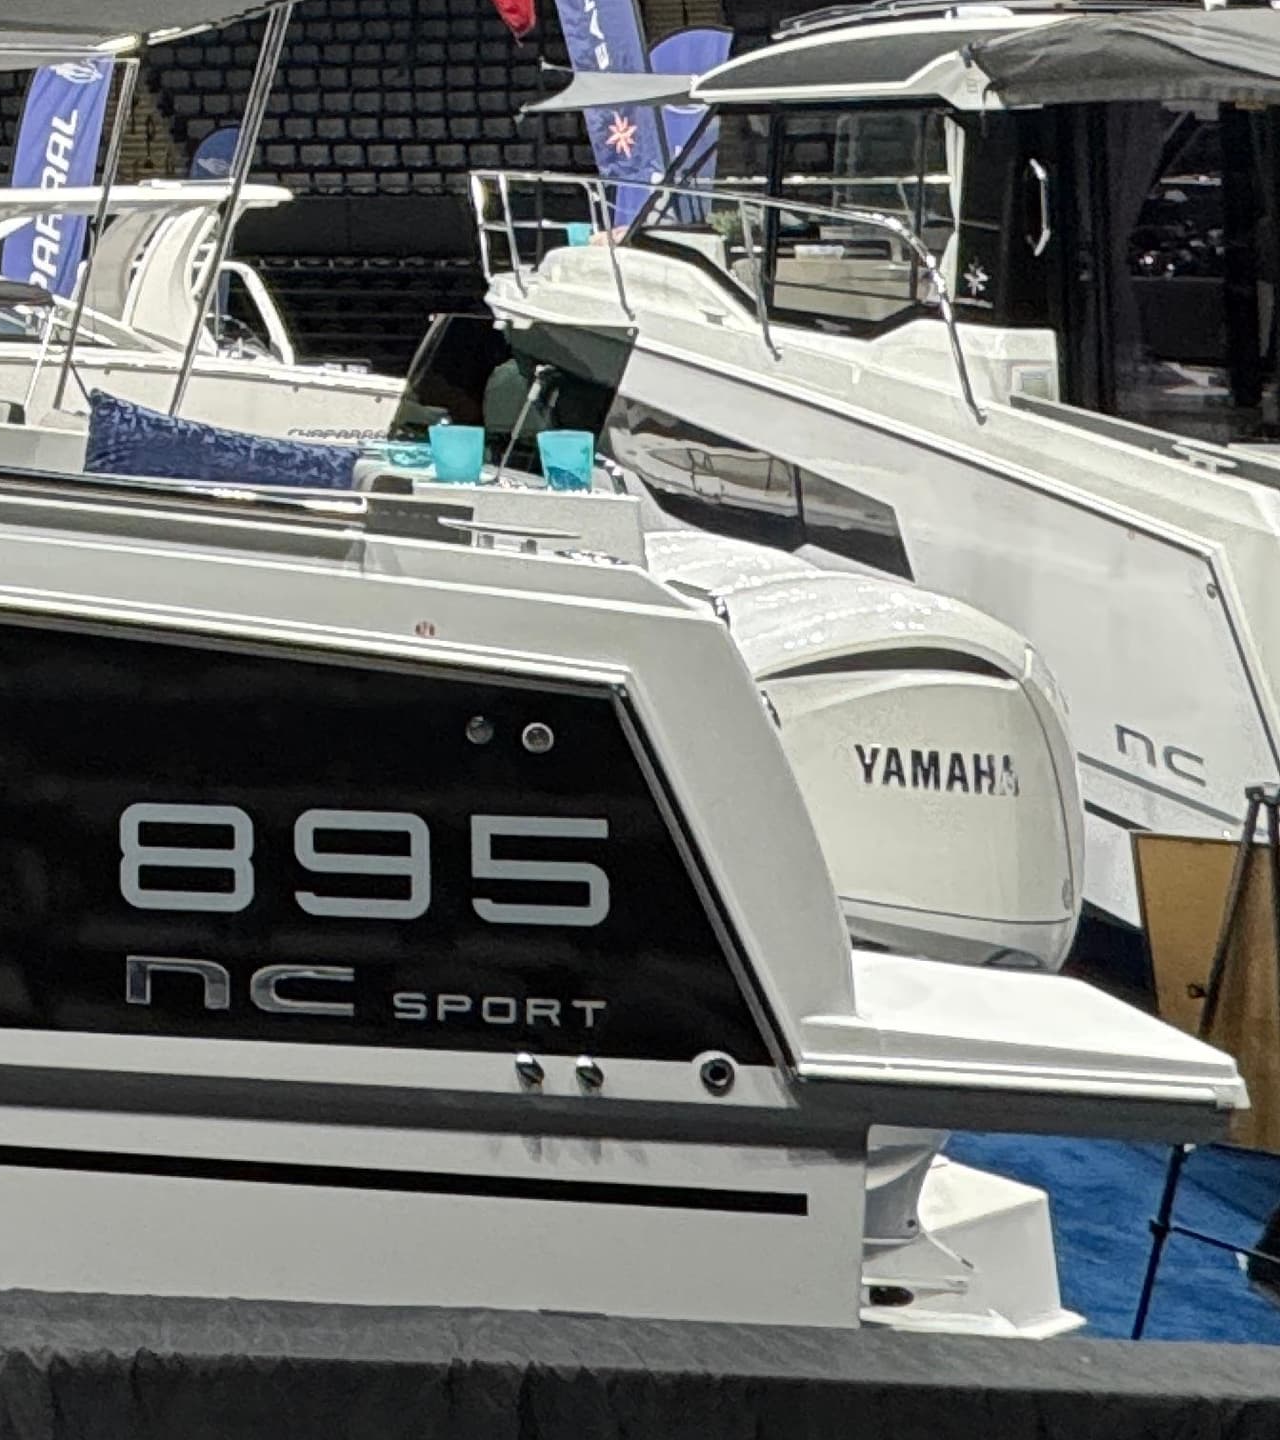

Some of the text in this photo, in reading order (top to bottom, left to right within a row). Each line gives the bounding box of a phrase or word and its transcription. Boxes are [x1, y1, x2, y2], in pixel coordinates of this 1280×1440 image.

[854, 743, 1021, 798] YAMAHA
[119, 802, 611, 926] 895
[392, 991, 608, 1028] SPORT
